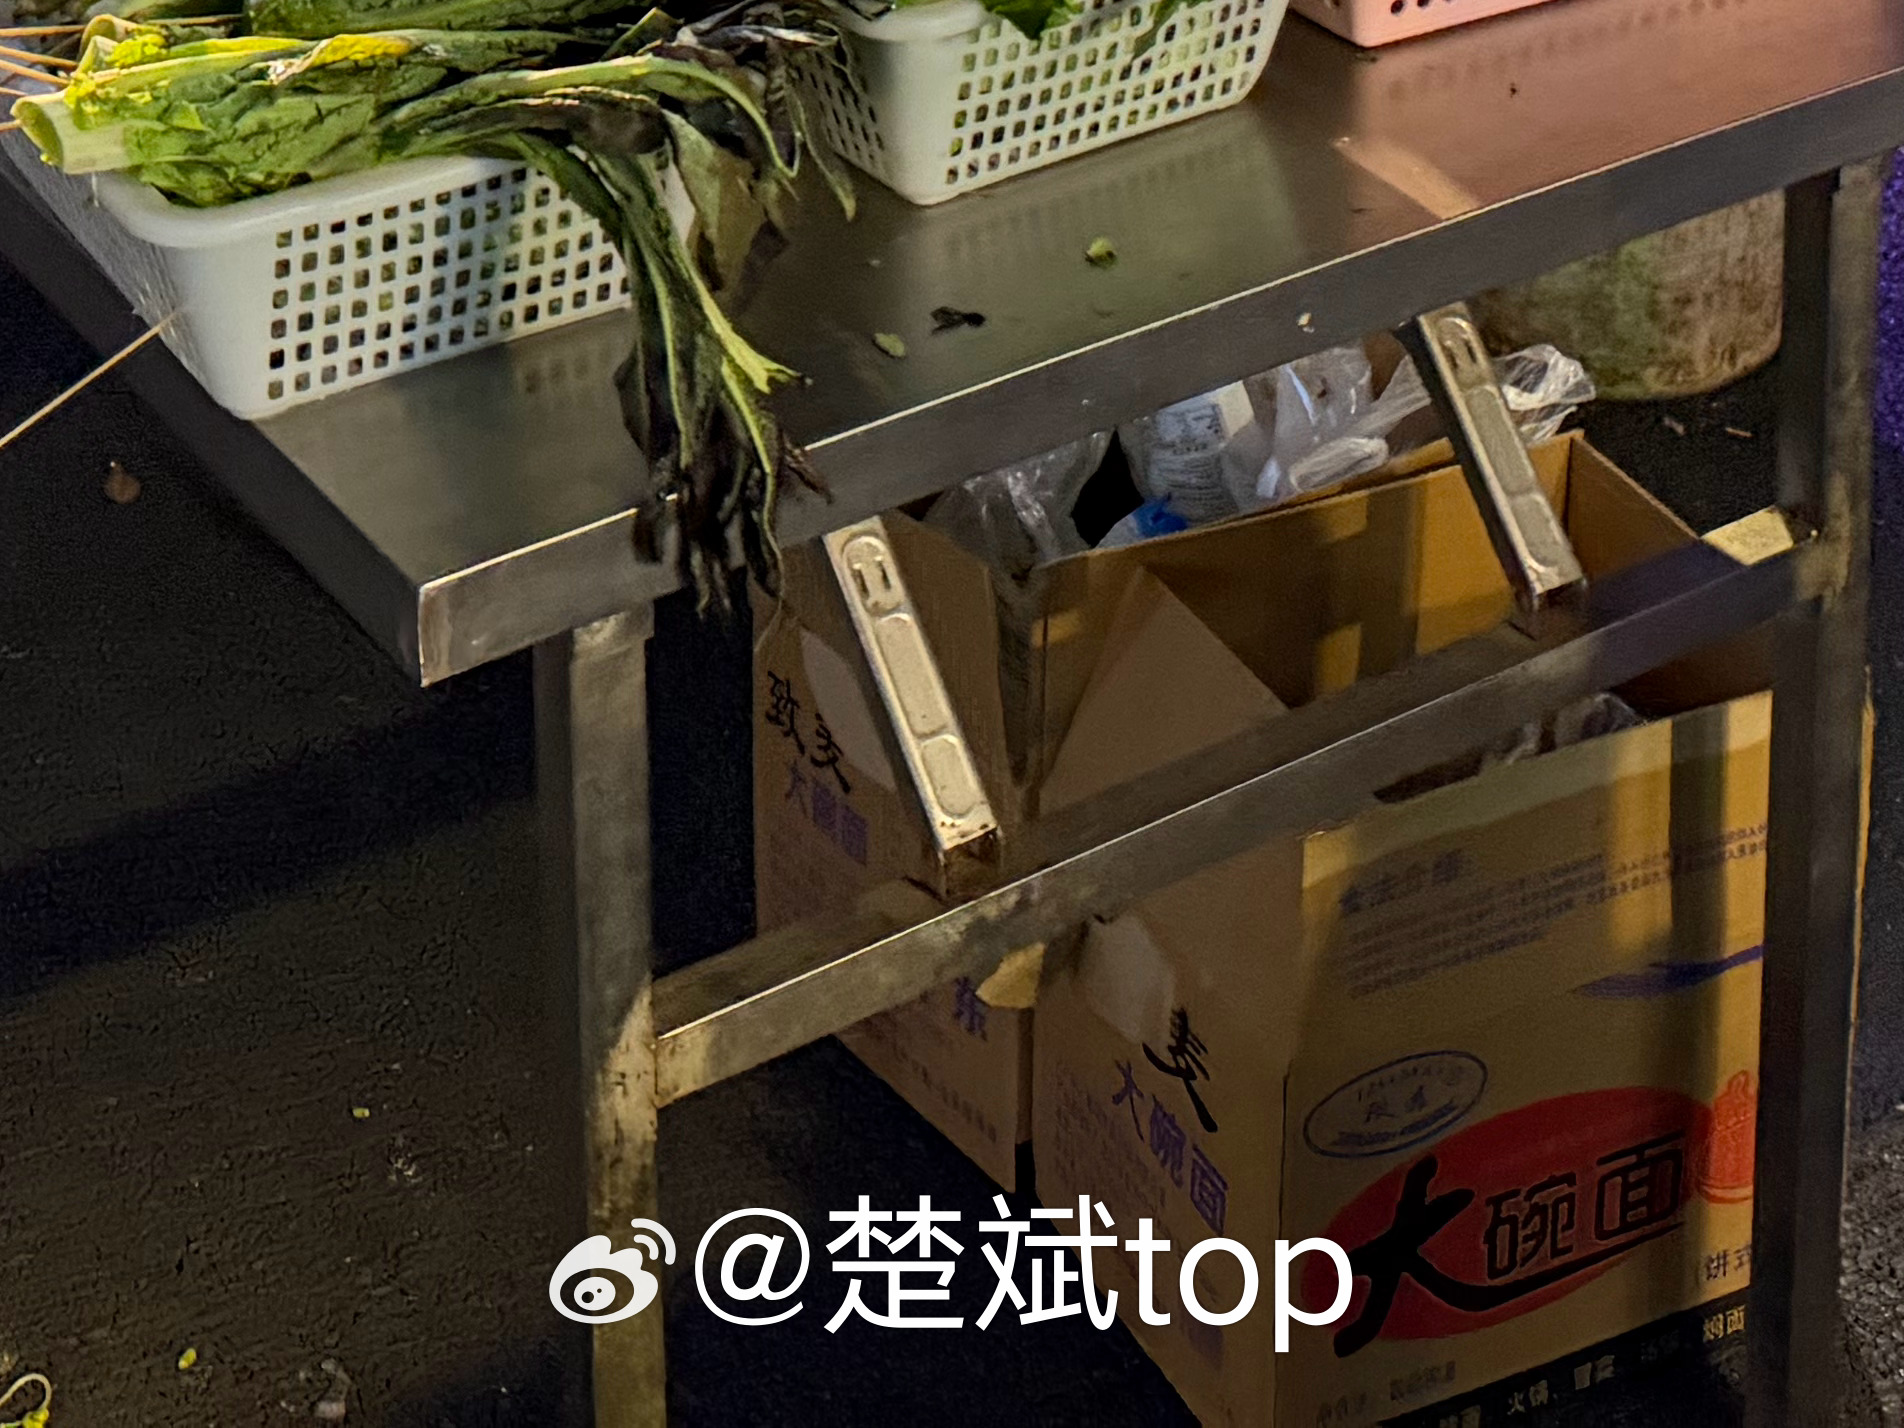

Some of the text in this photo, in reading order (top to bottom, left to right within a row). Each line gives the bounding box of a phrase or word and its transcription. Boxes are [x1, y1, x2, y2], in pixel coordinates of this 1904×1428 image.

[1111, 1058, 1229, 1236] 大碗面
[1333, 1128, 1686, 1358] 大碗面
